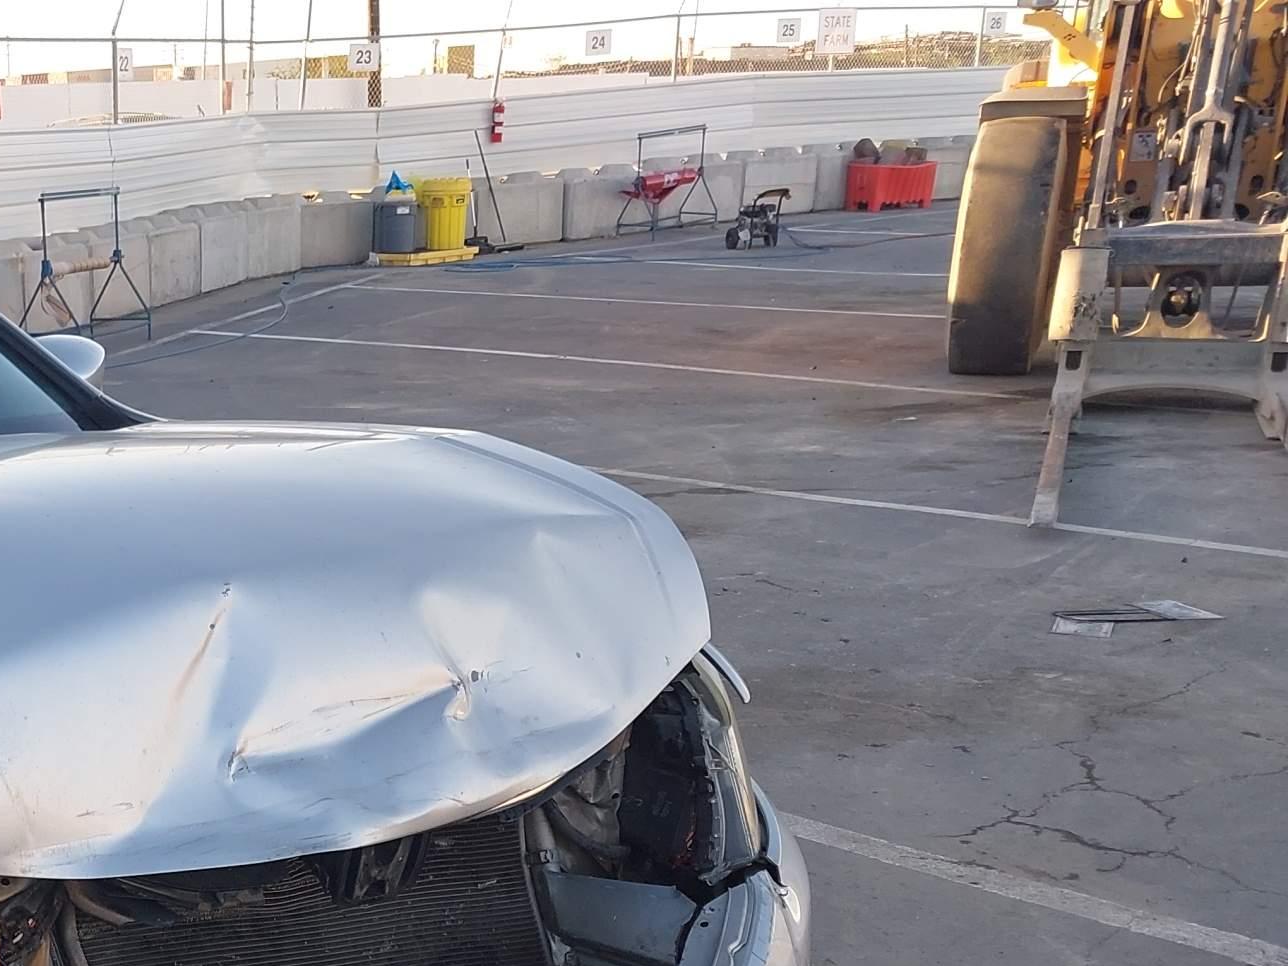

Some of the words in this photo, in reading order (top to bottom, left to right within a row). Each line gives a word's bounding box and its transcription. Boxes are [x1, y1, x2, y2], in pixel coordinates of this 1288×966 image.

[824, 15, 852, 28] STATE
[990, 17, 1002, 30] 26
[782, 24, 796, 37] 25
[592, 36, 605, 50] 24
[823, 34, 849, 47] FARM
[356, 50, 372, 64] 23
[119, 56, 129, 72] 22
